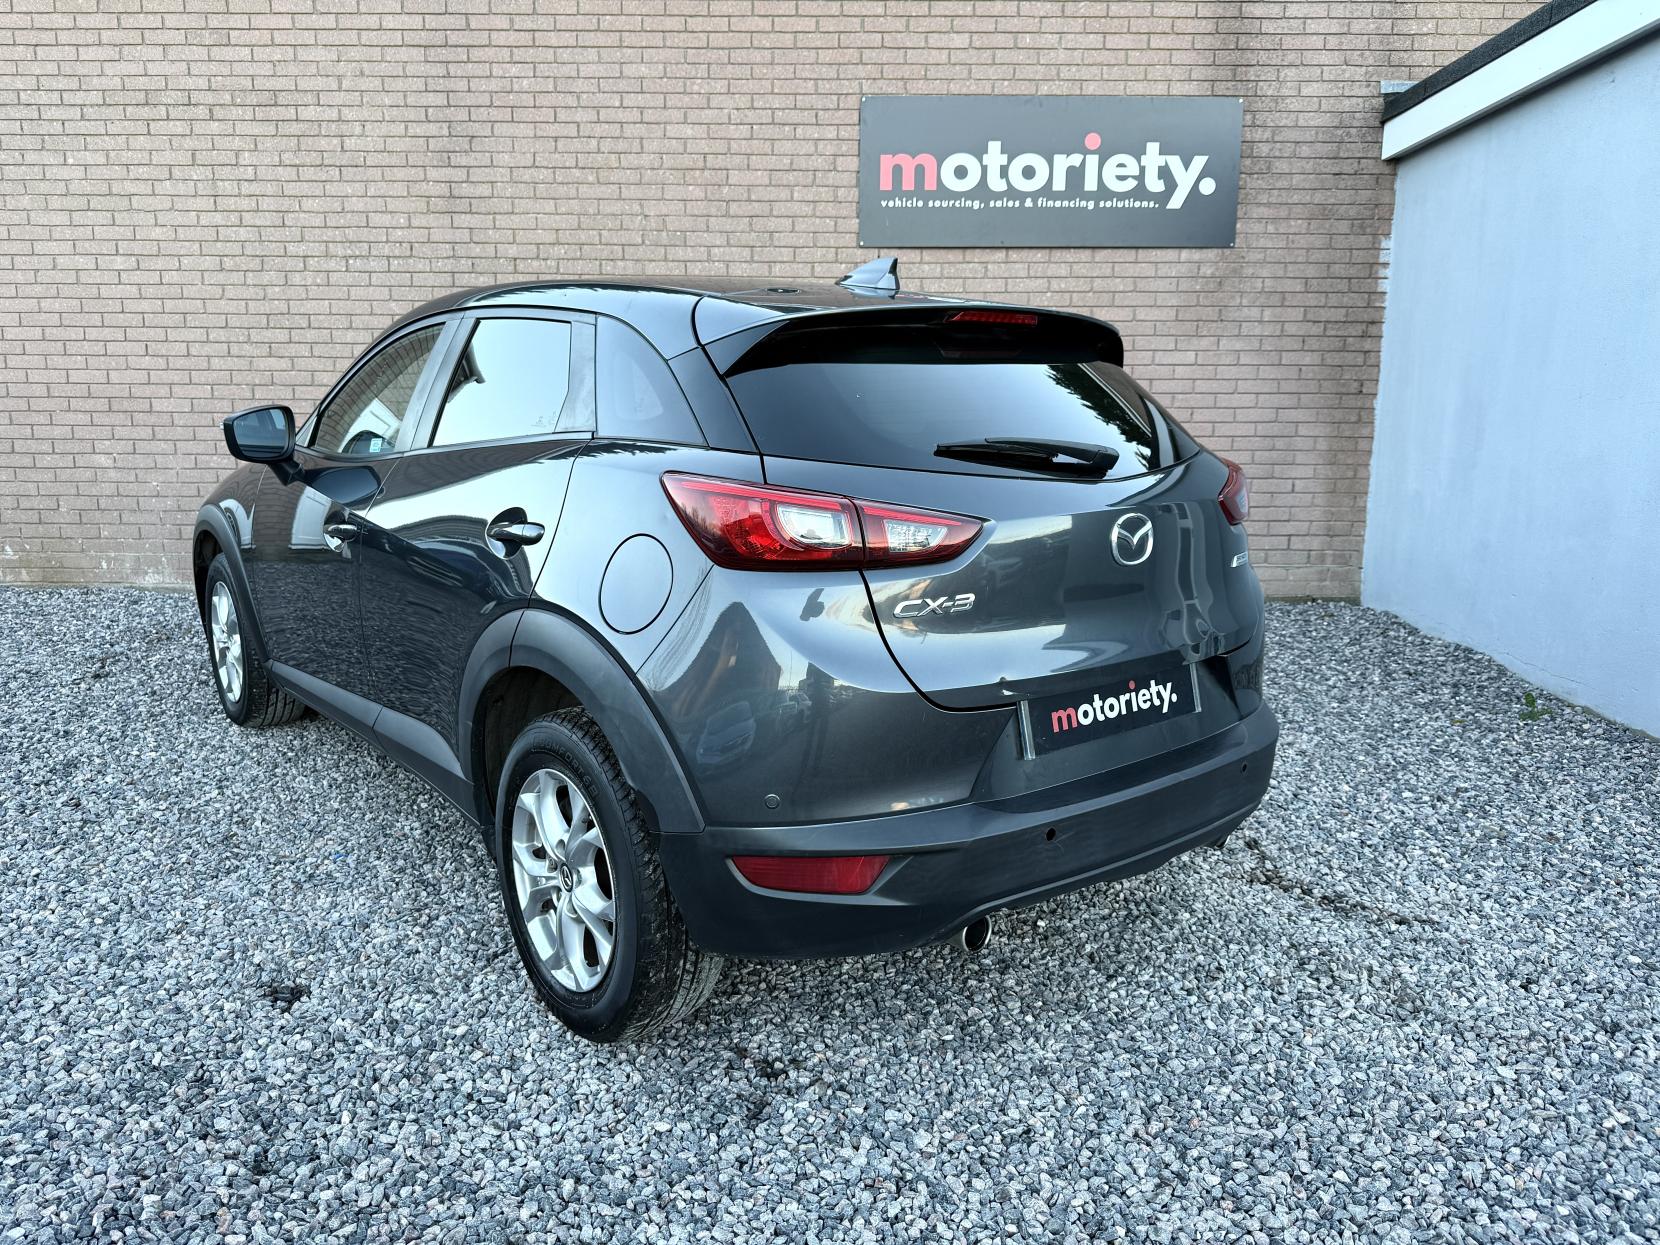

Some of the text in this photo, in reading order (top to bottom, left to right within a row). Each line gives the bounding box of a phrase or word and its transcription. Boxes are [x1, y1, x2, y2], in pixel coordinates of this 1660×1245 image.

[879, 132, 1217, 209] motoriety.
[880, 196, 1160, 210] vehicle sourcing, sales & financing solutions.
[893, 593, 976, 618] CX-3
[1051, 679, 1178, 734] motoriety.
